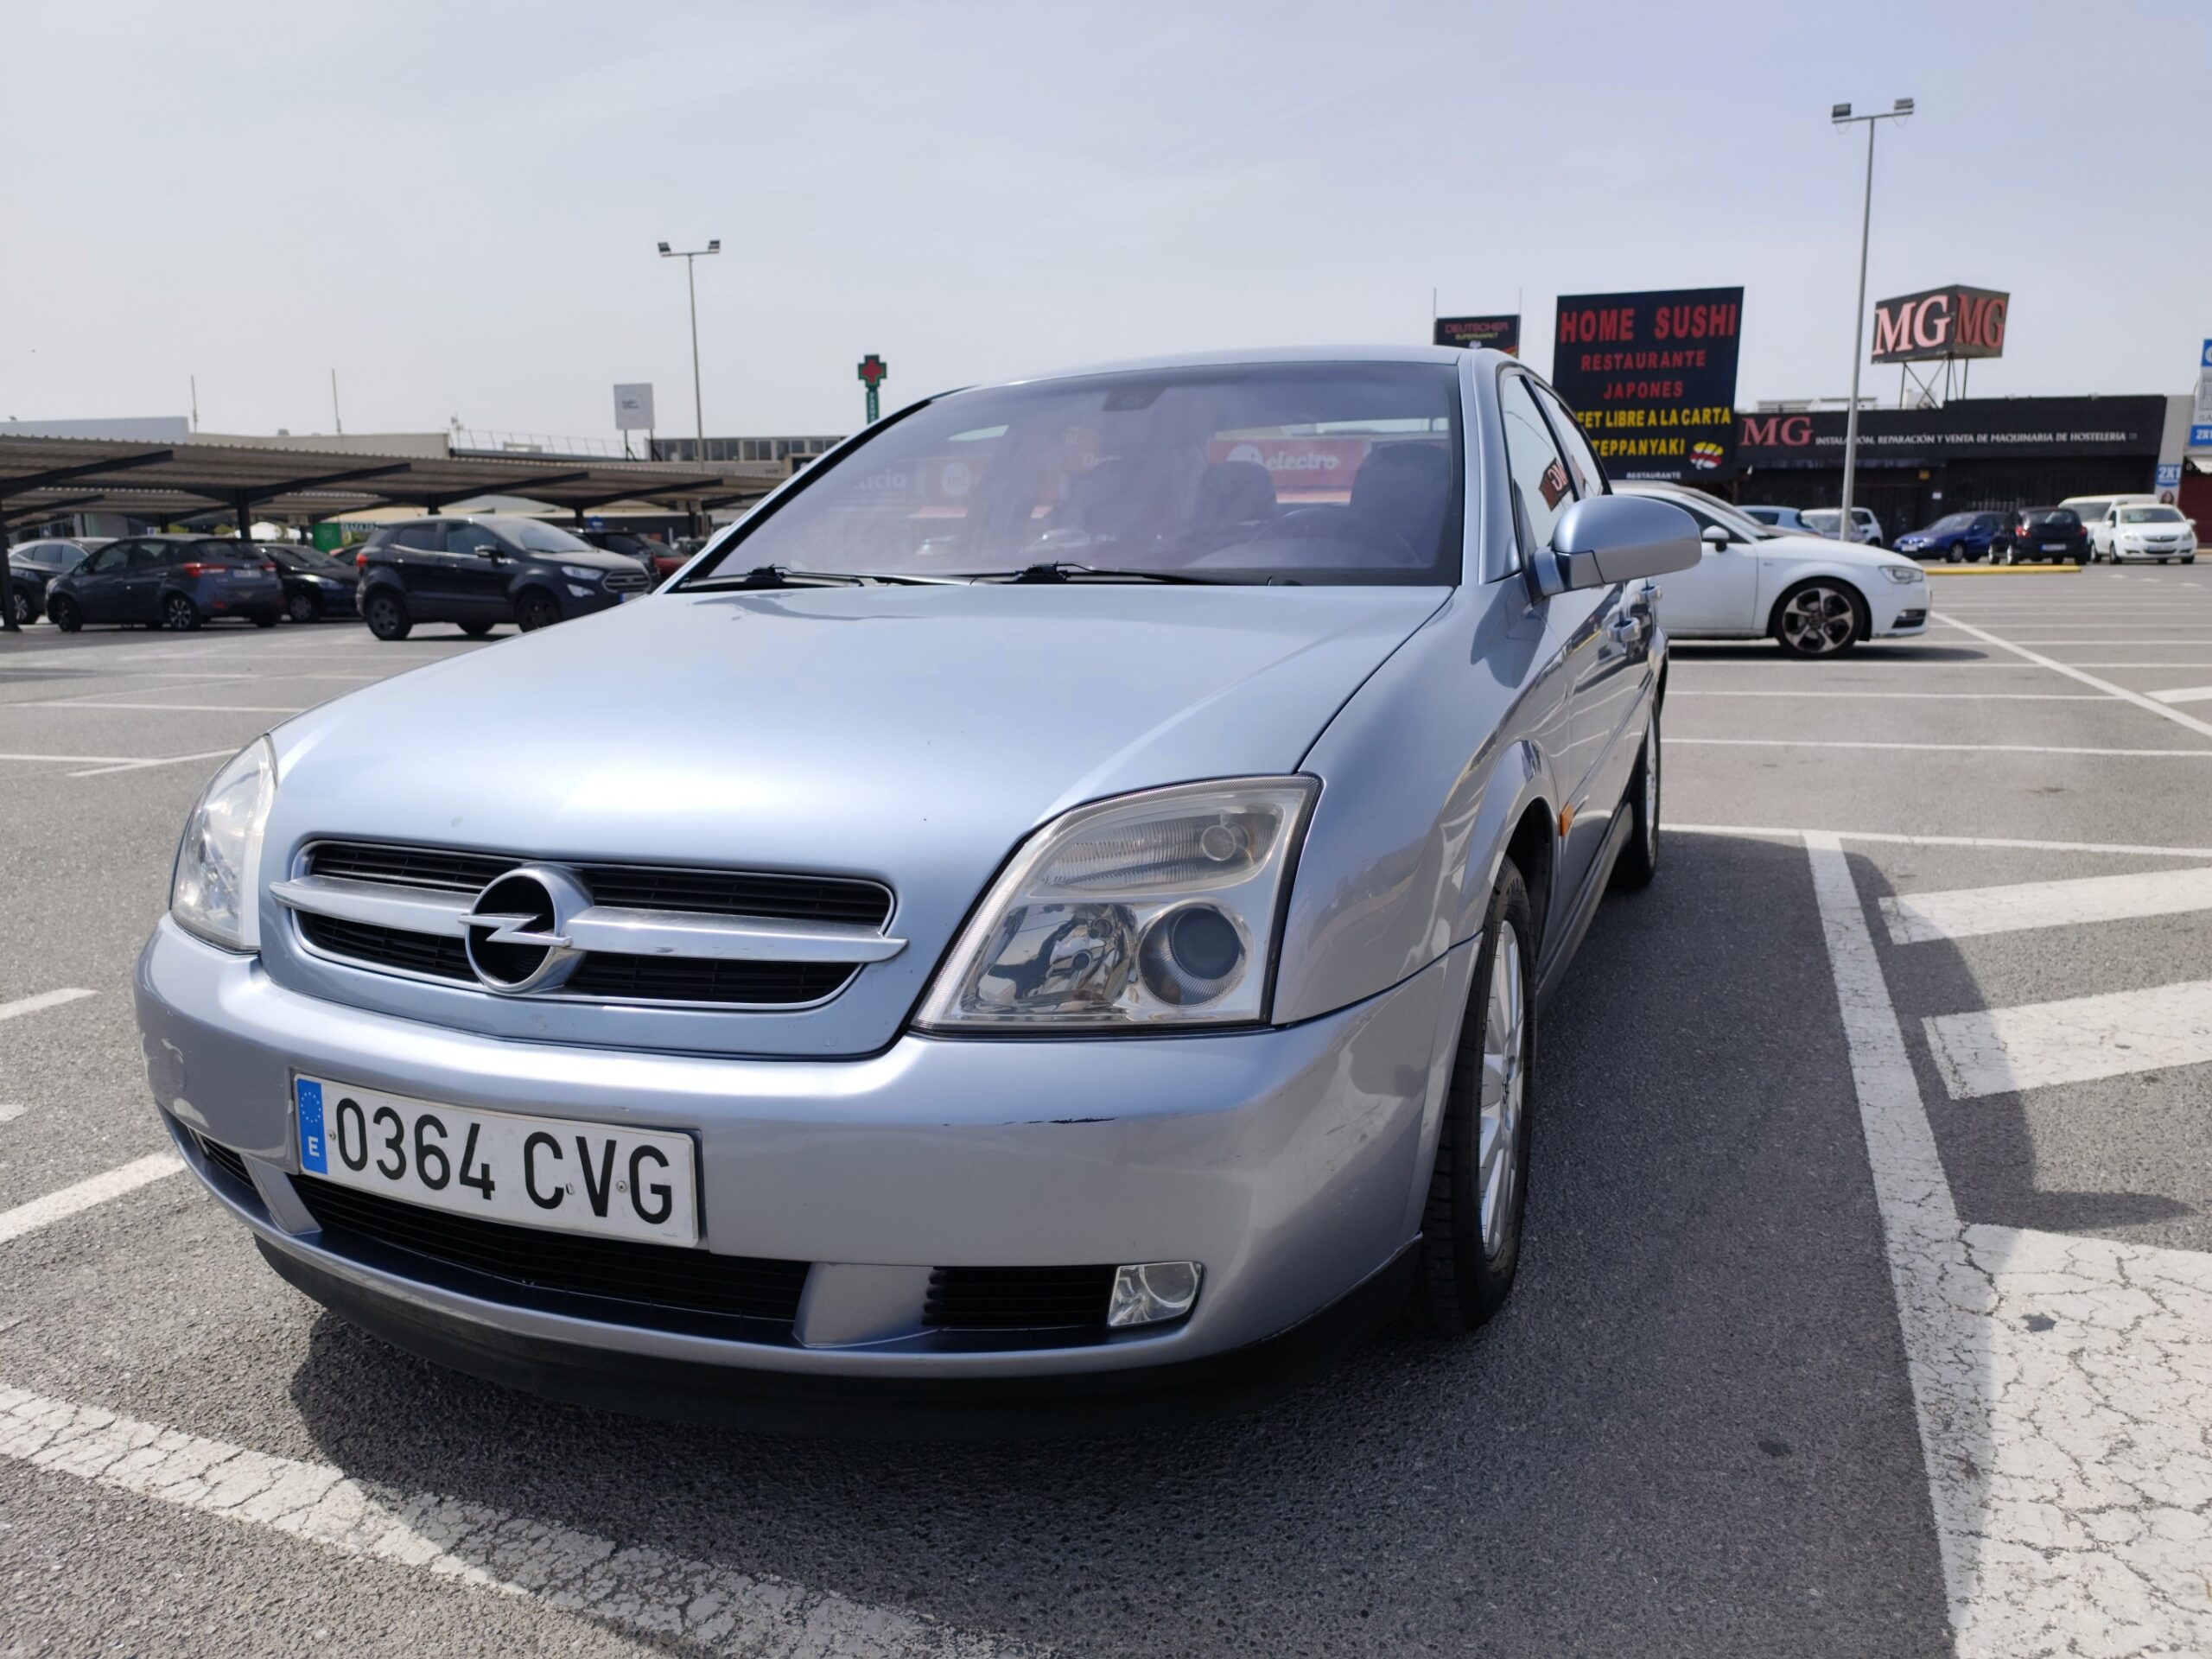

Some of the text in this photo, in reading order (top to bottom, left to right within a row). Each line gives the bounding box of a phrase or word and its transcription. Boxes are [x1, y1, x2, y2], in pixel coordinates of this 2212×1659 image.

[1445, 321, 1509, 334] DEUTSCHER
[1560, 303, 1737, 344] HOME SUSHI
[1872, 295, 1951, 356] MG
[1955, 295, 2005, 347] MG
[1581, 350, 1706, 372] RESTAURANTE
[1603, 381, 1683, 400] JAPONES
[1605, 410, 1645, 429] LIBRE
[1648, 409, 1657, 427] A
[1660, 409, 1677, 426] LA
[1681, 407, 1731, 426] CARTA
[1740, 416, 1813, 447] MG
[1936, 434, 1944, 444] Y
[1944, 433, 1974, 444] VENTA
[1976, 434, 1989, 443] DE
[1990, 433, 2053, 443] MAQUINARIA
[2056, 432, 2068, 442] DE
[1592, 438, 1685, 457] TEPPANYAKI
[1266, 451, 1340, 471] electro
[1626, 471, 1681, 480] RESTAURANTE
[308, 1136, 320, 1157] E
[336, 1097, 672, 1224] 0364 CVG
